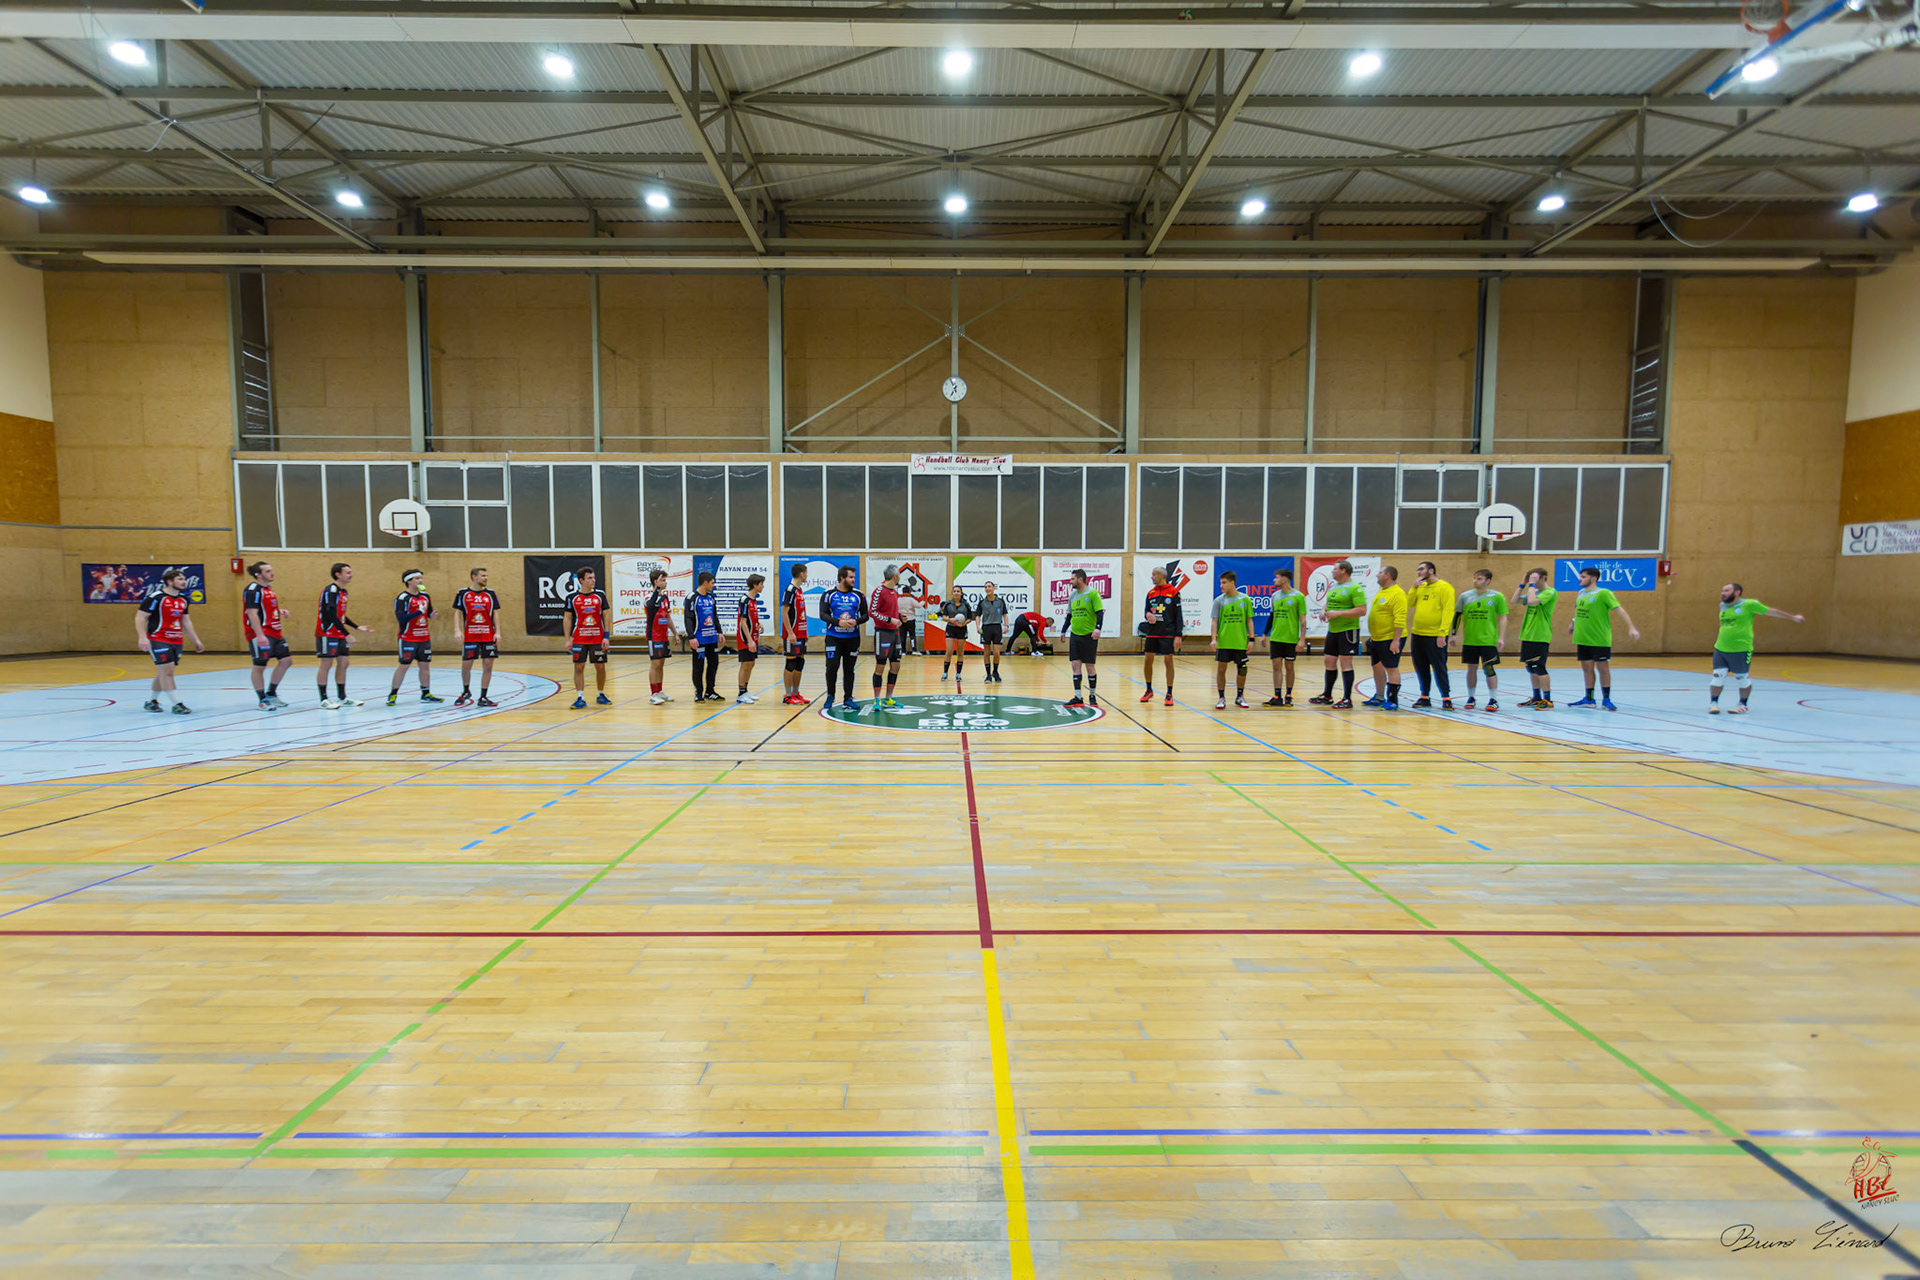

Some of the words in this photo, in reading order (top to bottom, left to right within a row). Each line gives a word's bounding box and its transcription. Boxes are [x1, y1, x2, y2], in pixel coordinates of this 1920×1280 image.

[971, 457, 990, 465] Nancy
[1595, 561, 1612, 569] ville
[1612, 561, 1622, 569] de
[1563, 561, 1647, 589] Nncy
[812, 578, 840, 587] Hoque
